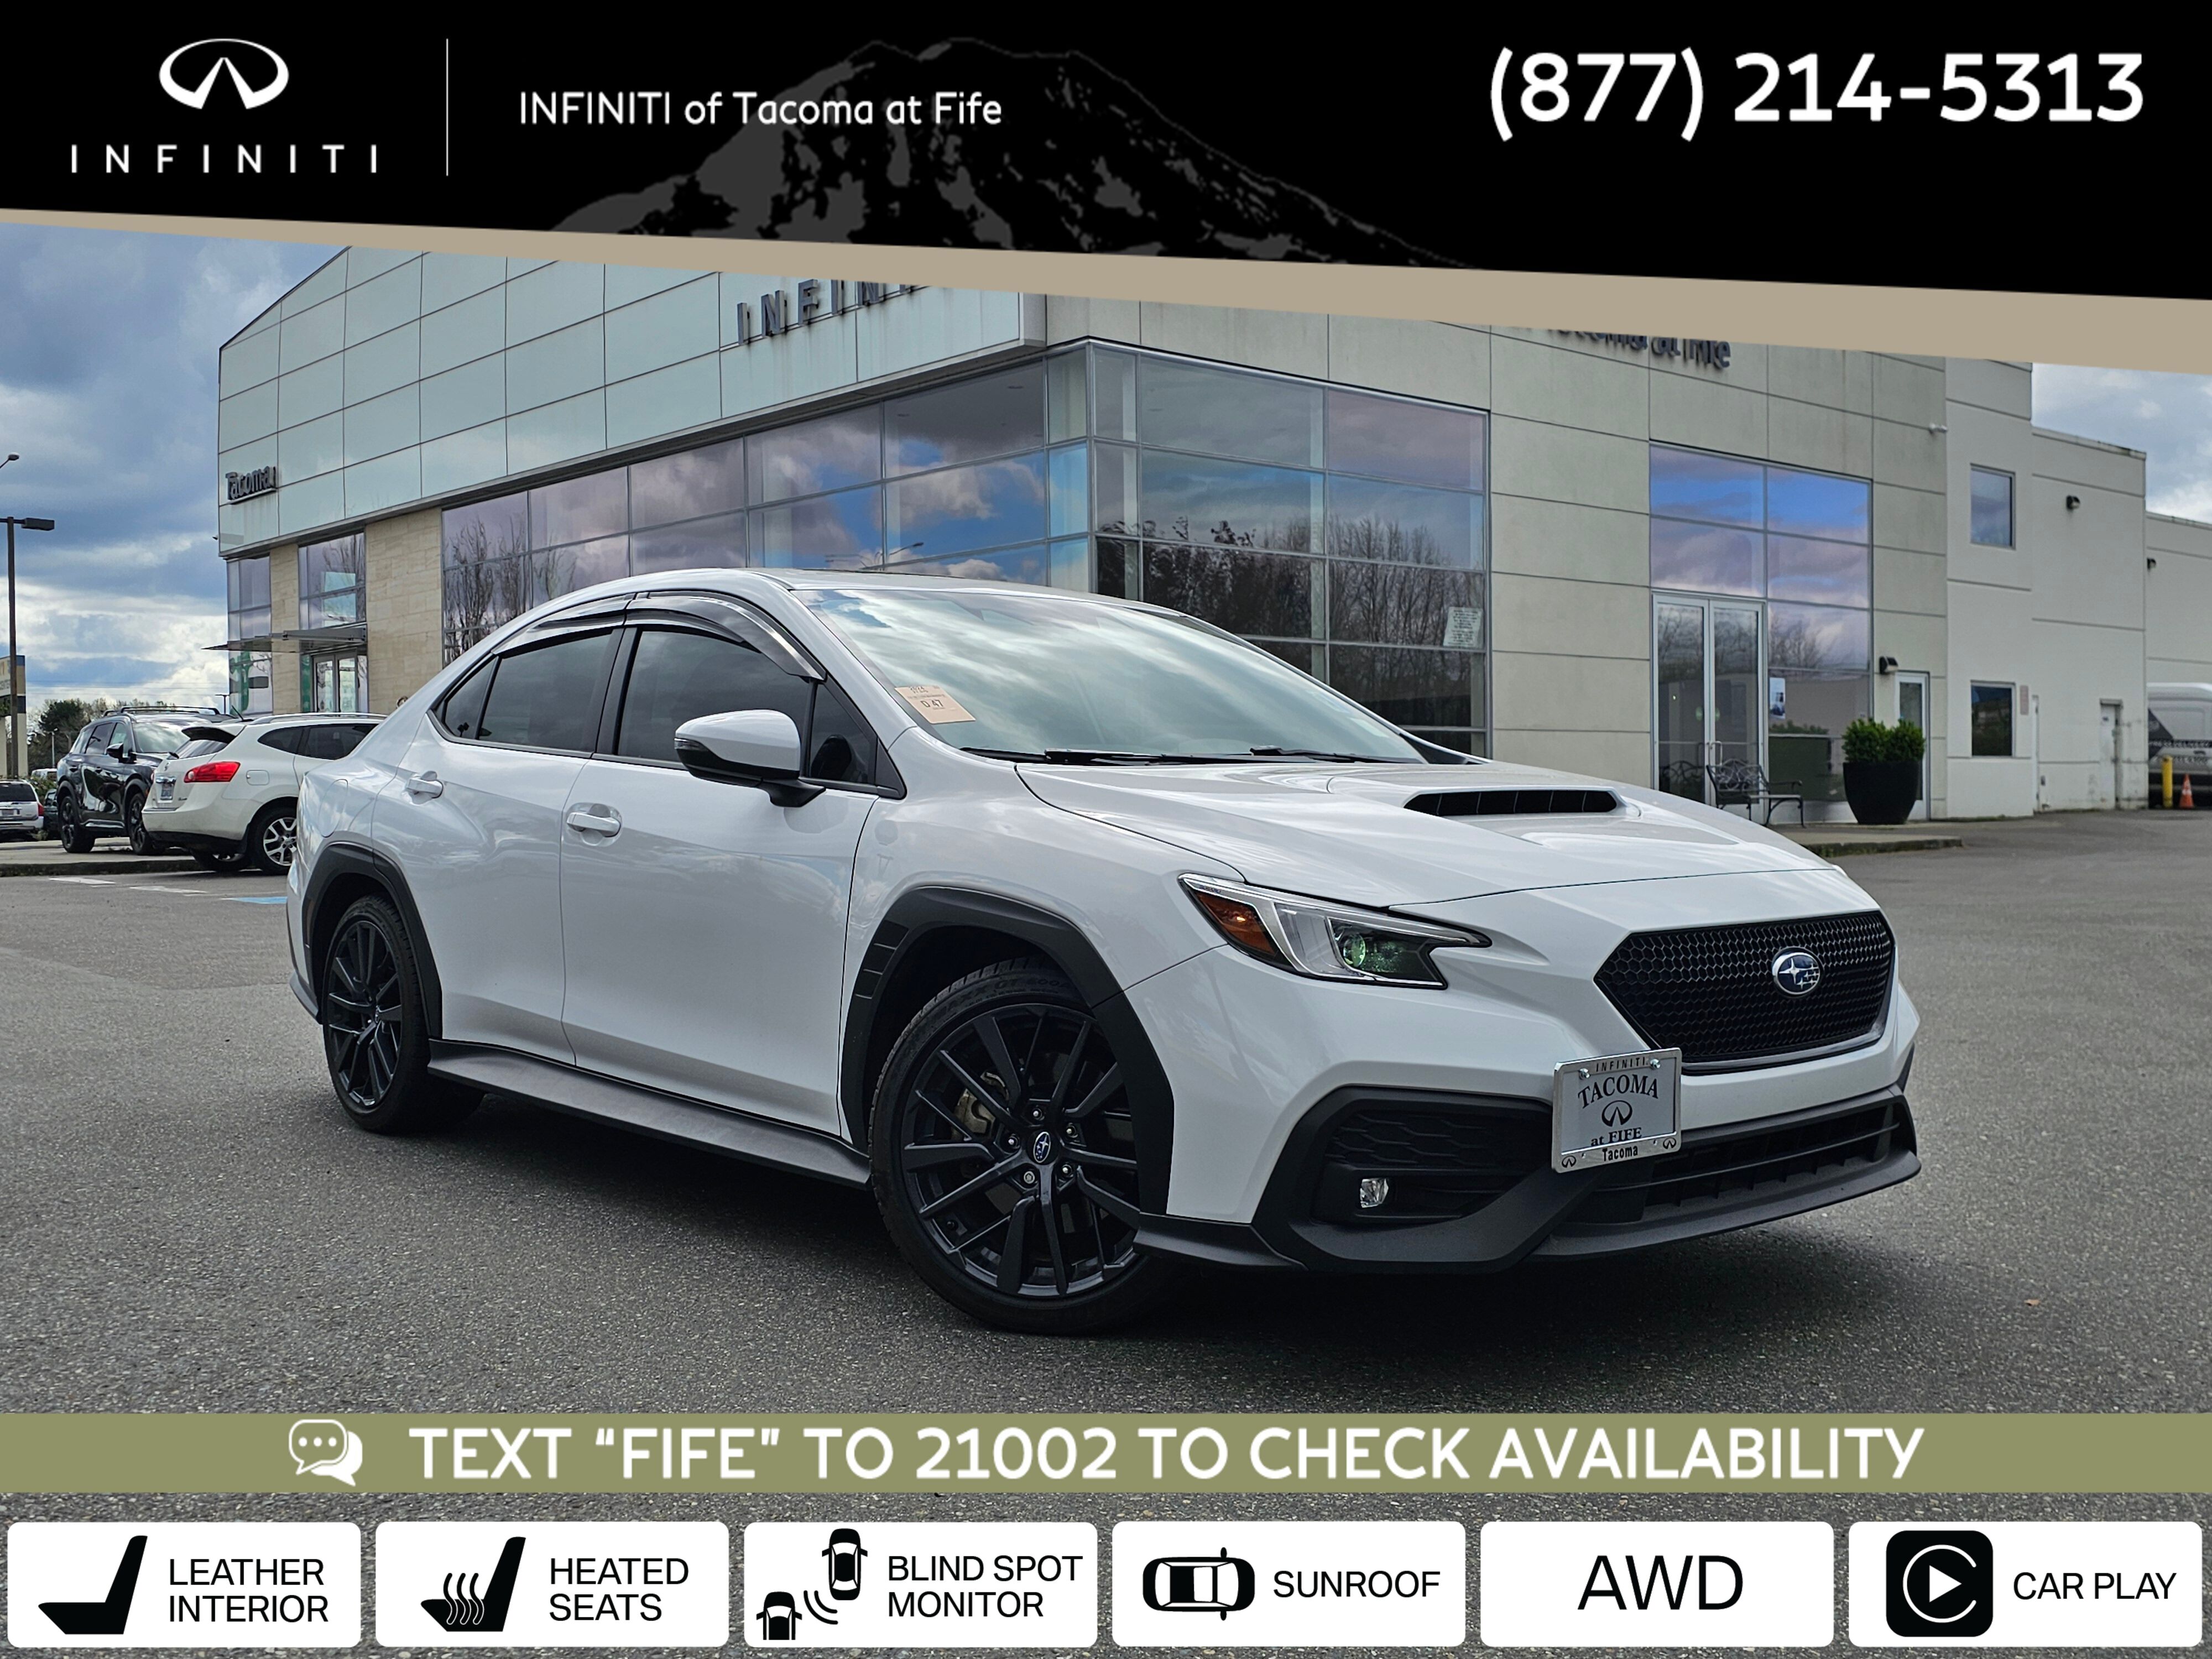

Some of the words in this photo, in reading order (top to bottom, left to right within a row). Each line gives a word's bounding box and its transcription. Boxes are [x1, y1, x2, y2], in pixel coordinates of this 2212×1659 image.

[226, 466, 276, 500] Tacoma
[1596, 1057, 1645, 1072] INFINITI
[1578, 1074, 1658, 1109] TACOMA
[1591, 1135, 1604, 1146] at
[1608, 1127, 1642, 1144] FIFE
[1603, 1145, 1638, 1162] Tacoma
